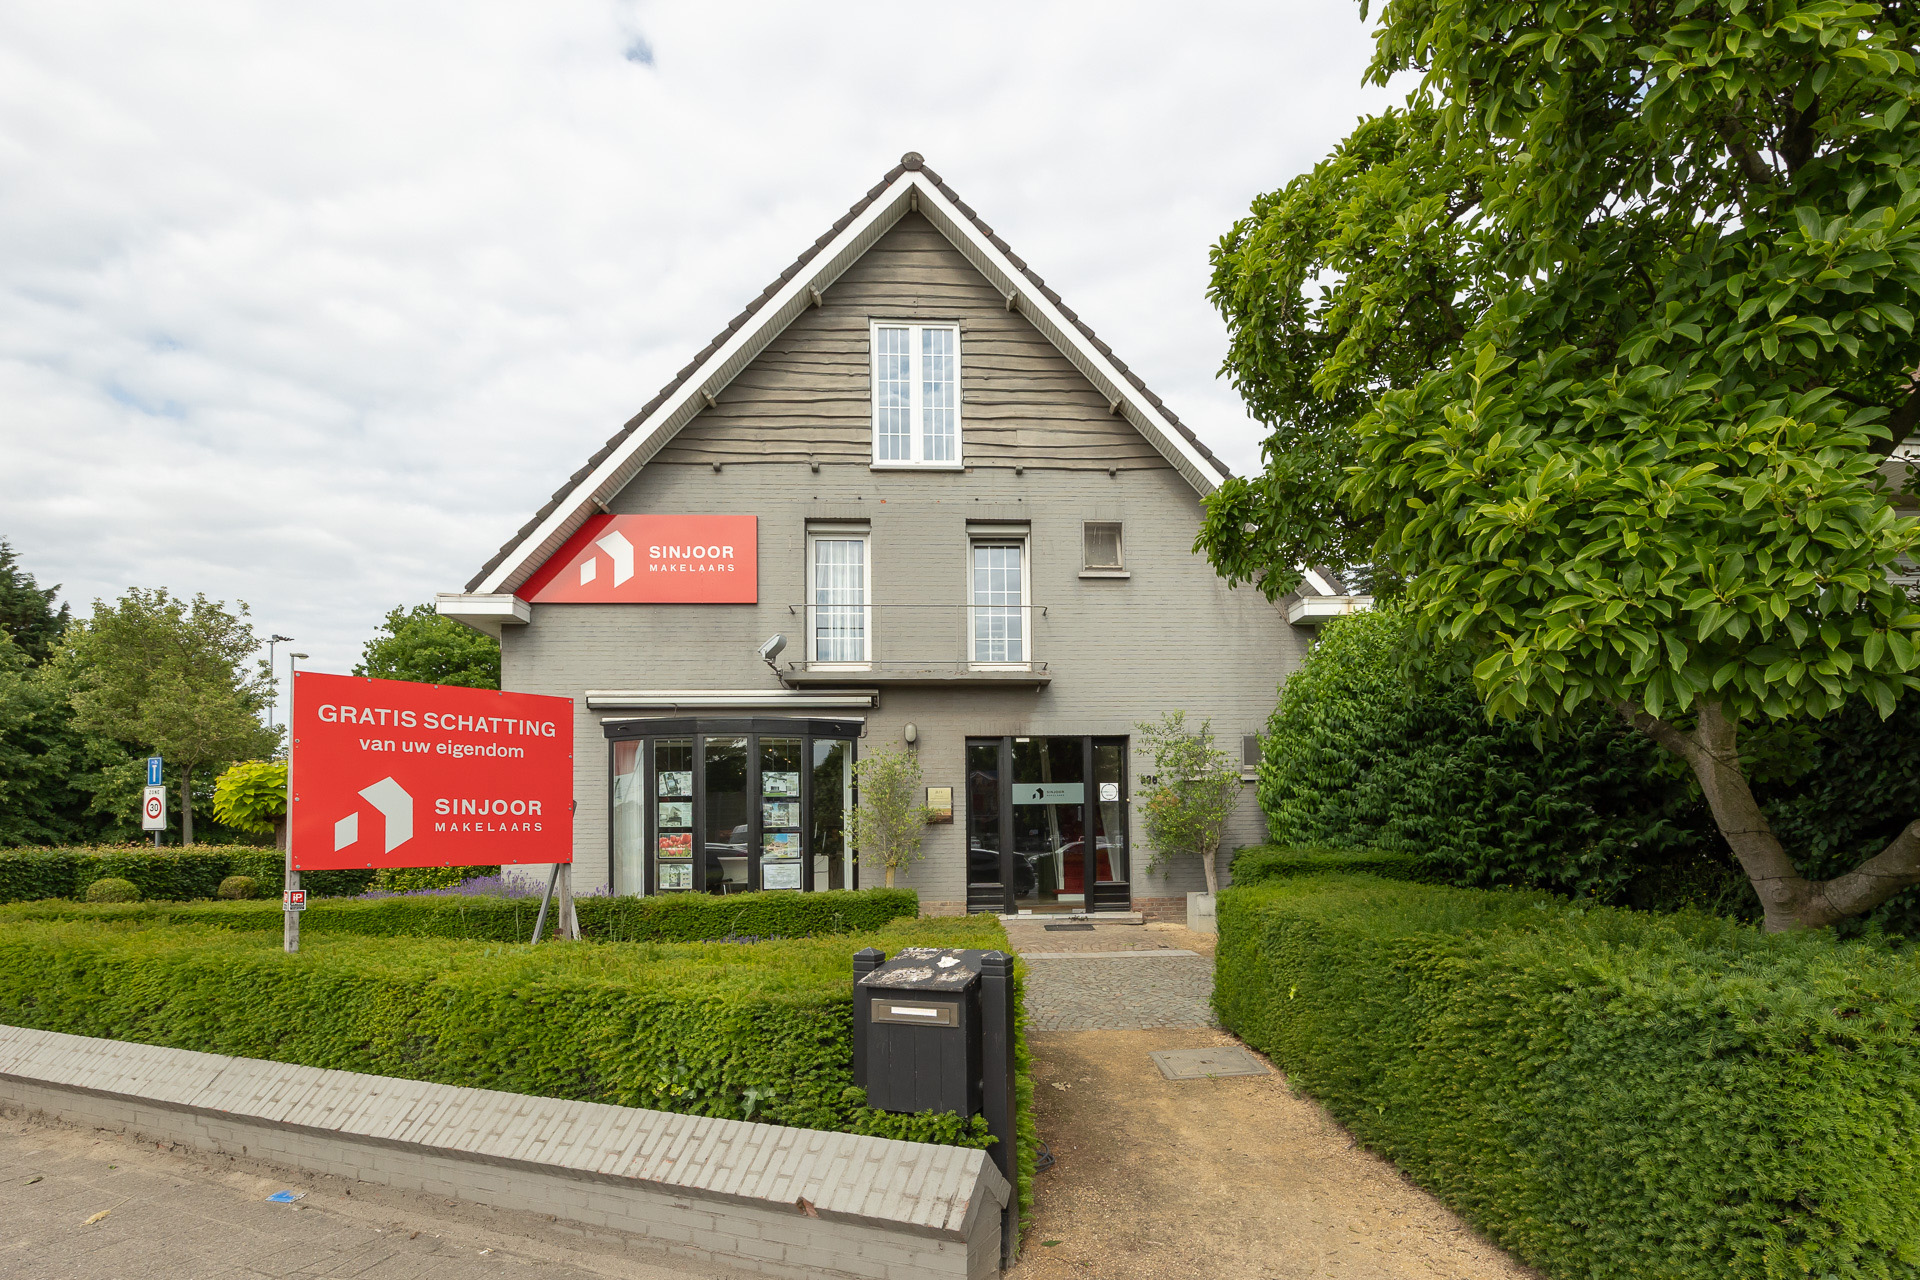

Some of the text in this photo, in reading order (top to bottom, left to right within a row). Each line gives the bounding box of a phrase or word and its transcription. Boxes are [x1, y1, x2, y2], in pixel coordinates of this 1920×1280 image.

[649, 545, 735, 559] SINJOOR
[649, 563, 735, 572] MAKELAARS
[317, 704, 556, 738] GRATIS SCHATTING
[359, 738, 524, 759] van uw eigendom
[150, 803, 159, 812] 30
[434, 798, 542, 816] SINJOOR
[434, 822, 543, 832] MAKELAARS
